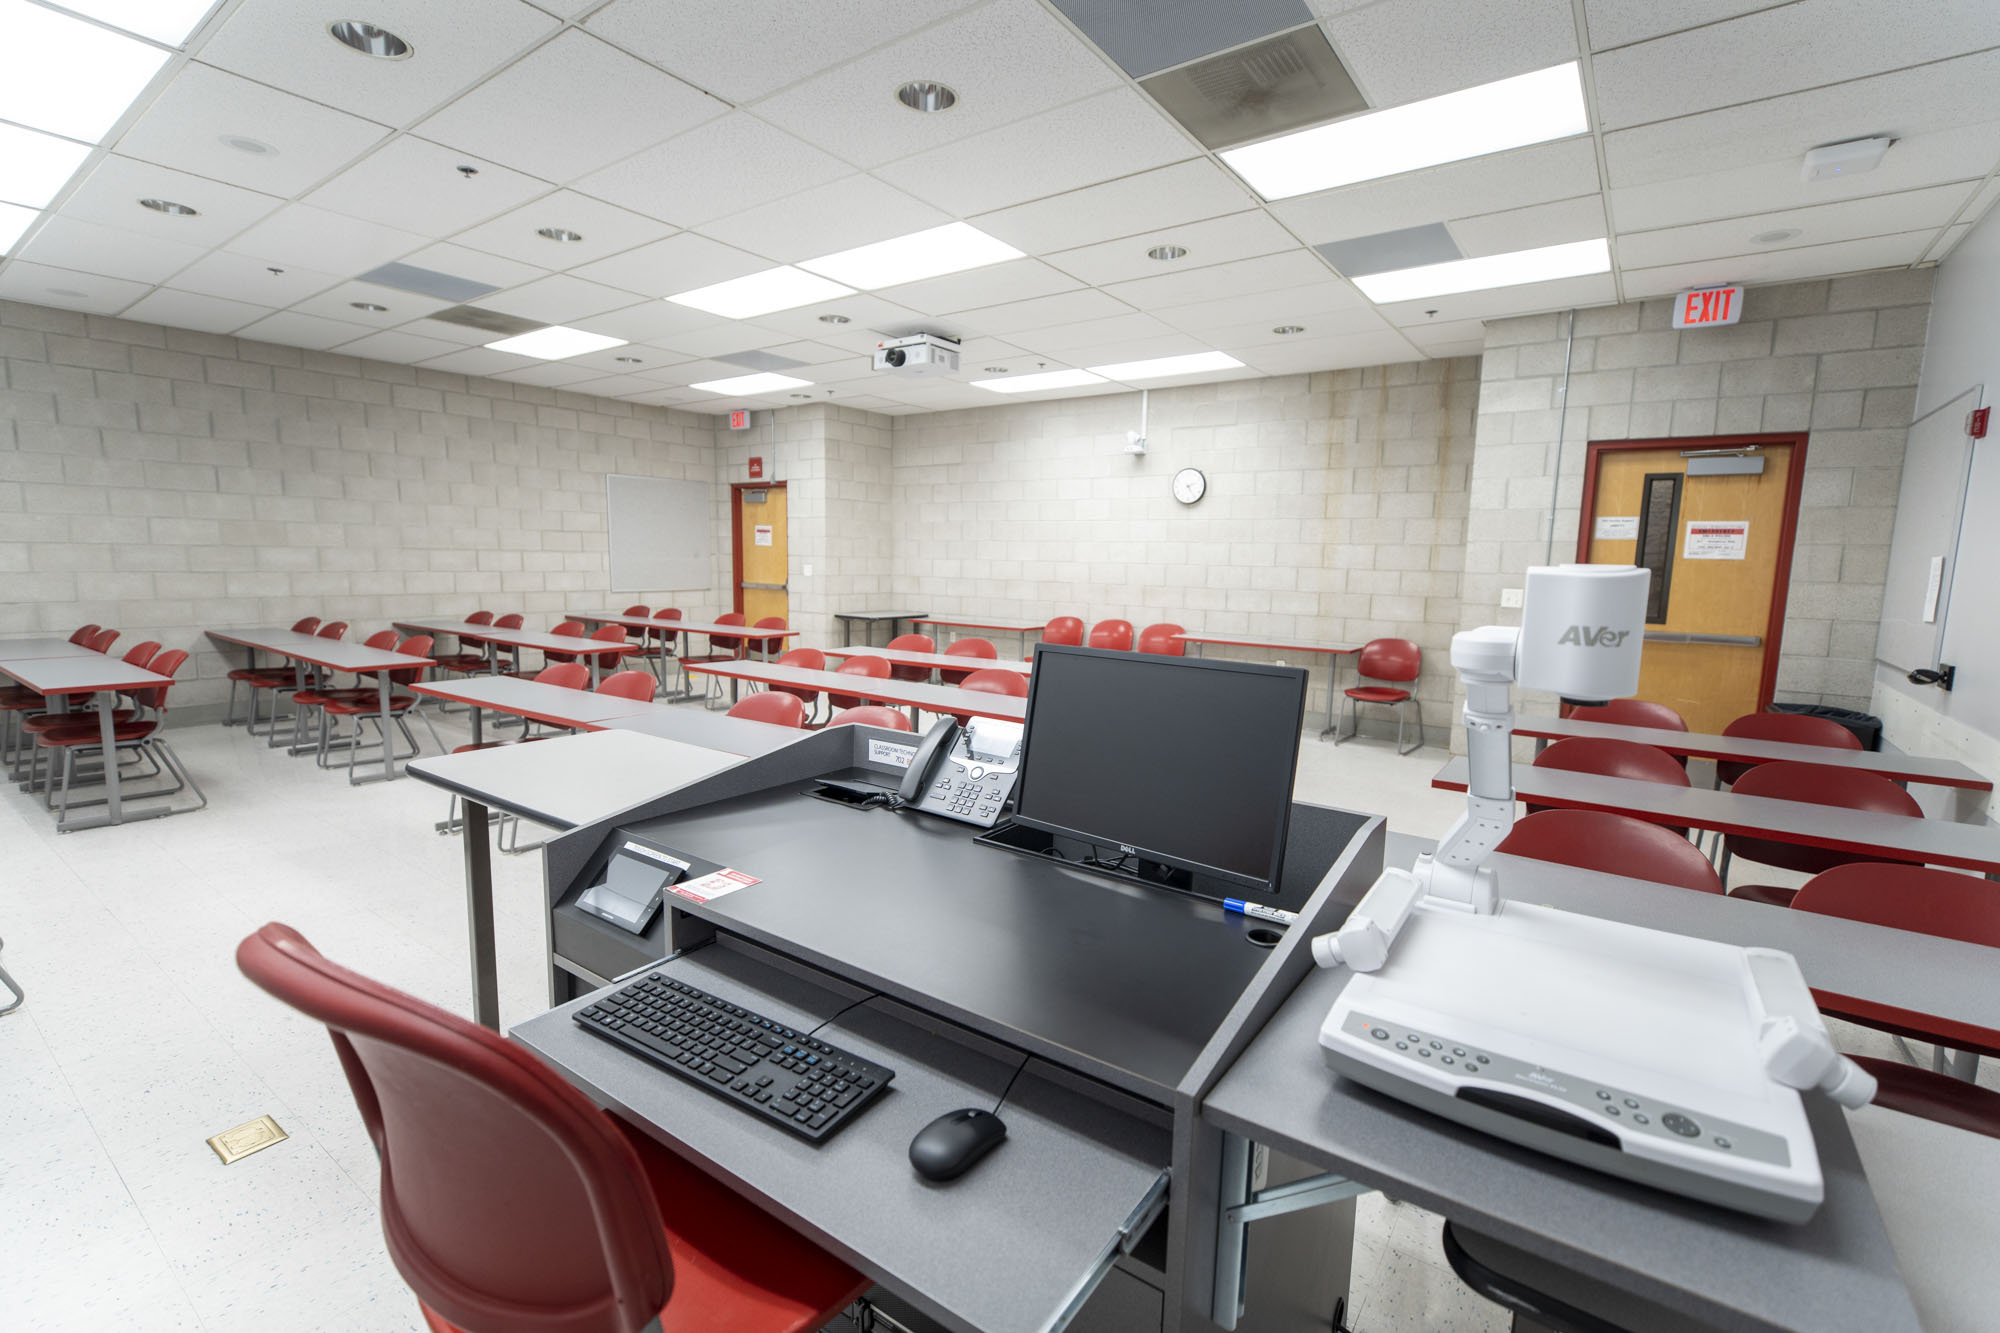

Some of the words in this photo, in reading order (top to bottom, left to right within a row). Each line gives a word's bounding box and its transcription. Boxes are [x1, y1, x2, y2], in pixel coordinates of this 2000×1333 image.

[1684, 288, 1736, 325] EXIT
[731, 411, 745, 428] EXIT
[1558, 625, 1631, 648] AVer
[874, 744, 899, 753] CLASSROOM
[874, 750, 892, 758] SUPPORT
[895, 755, 905, 765] 702
